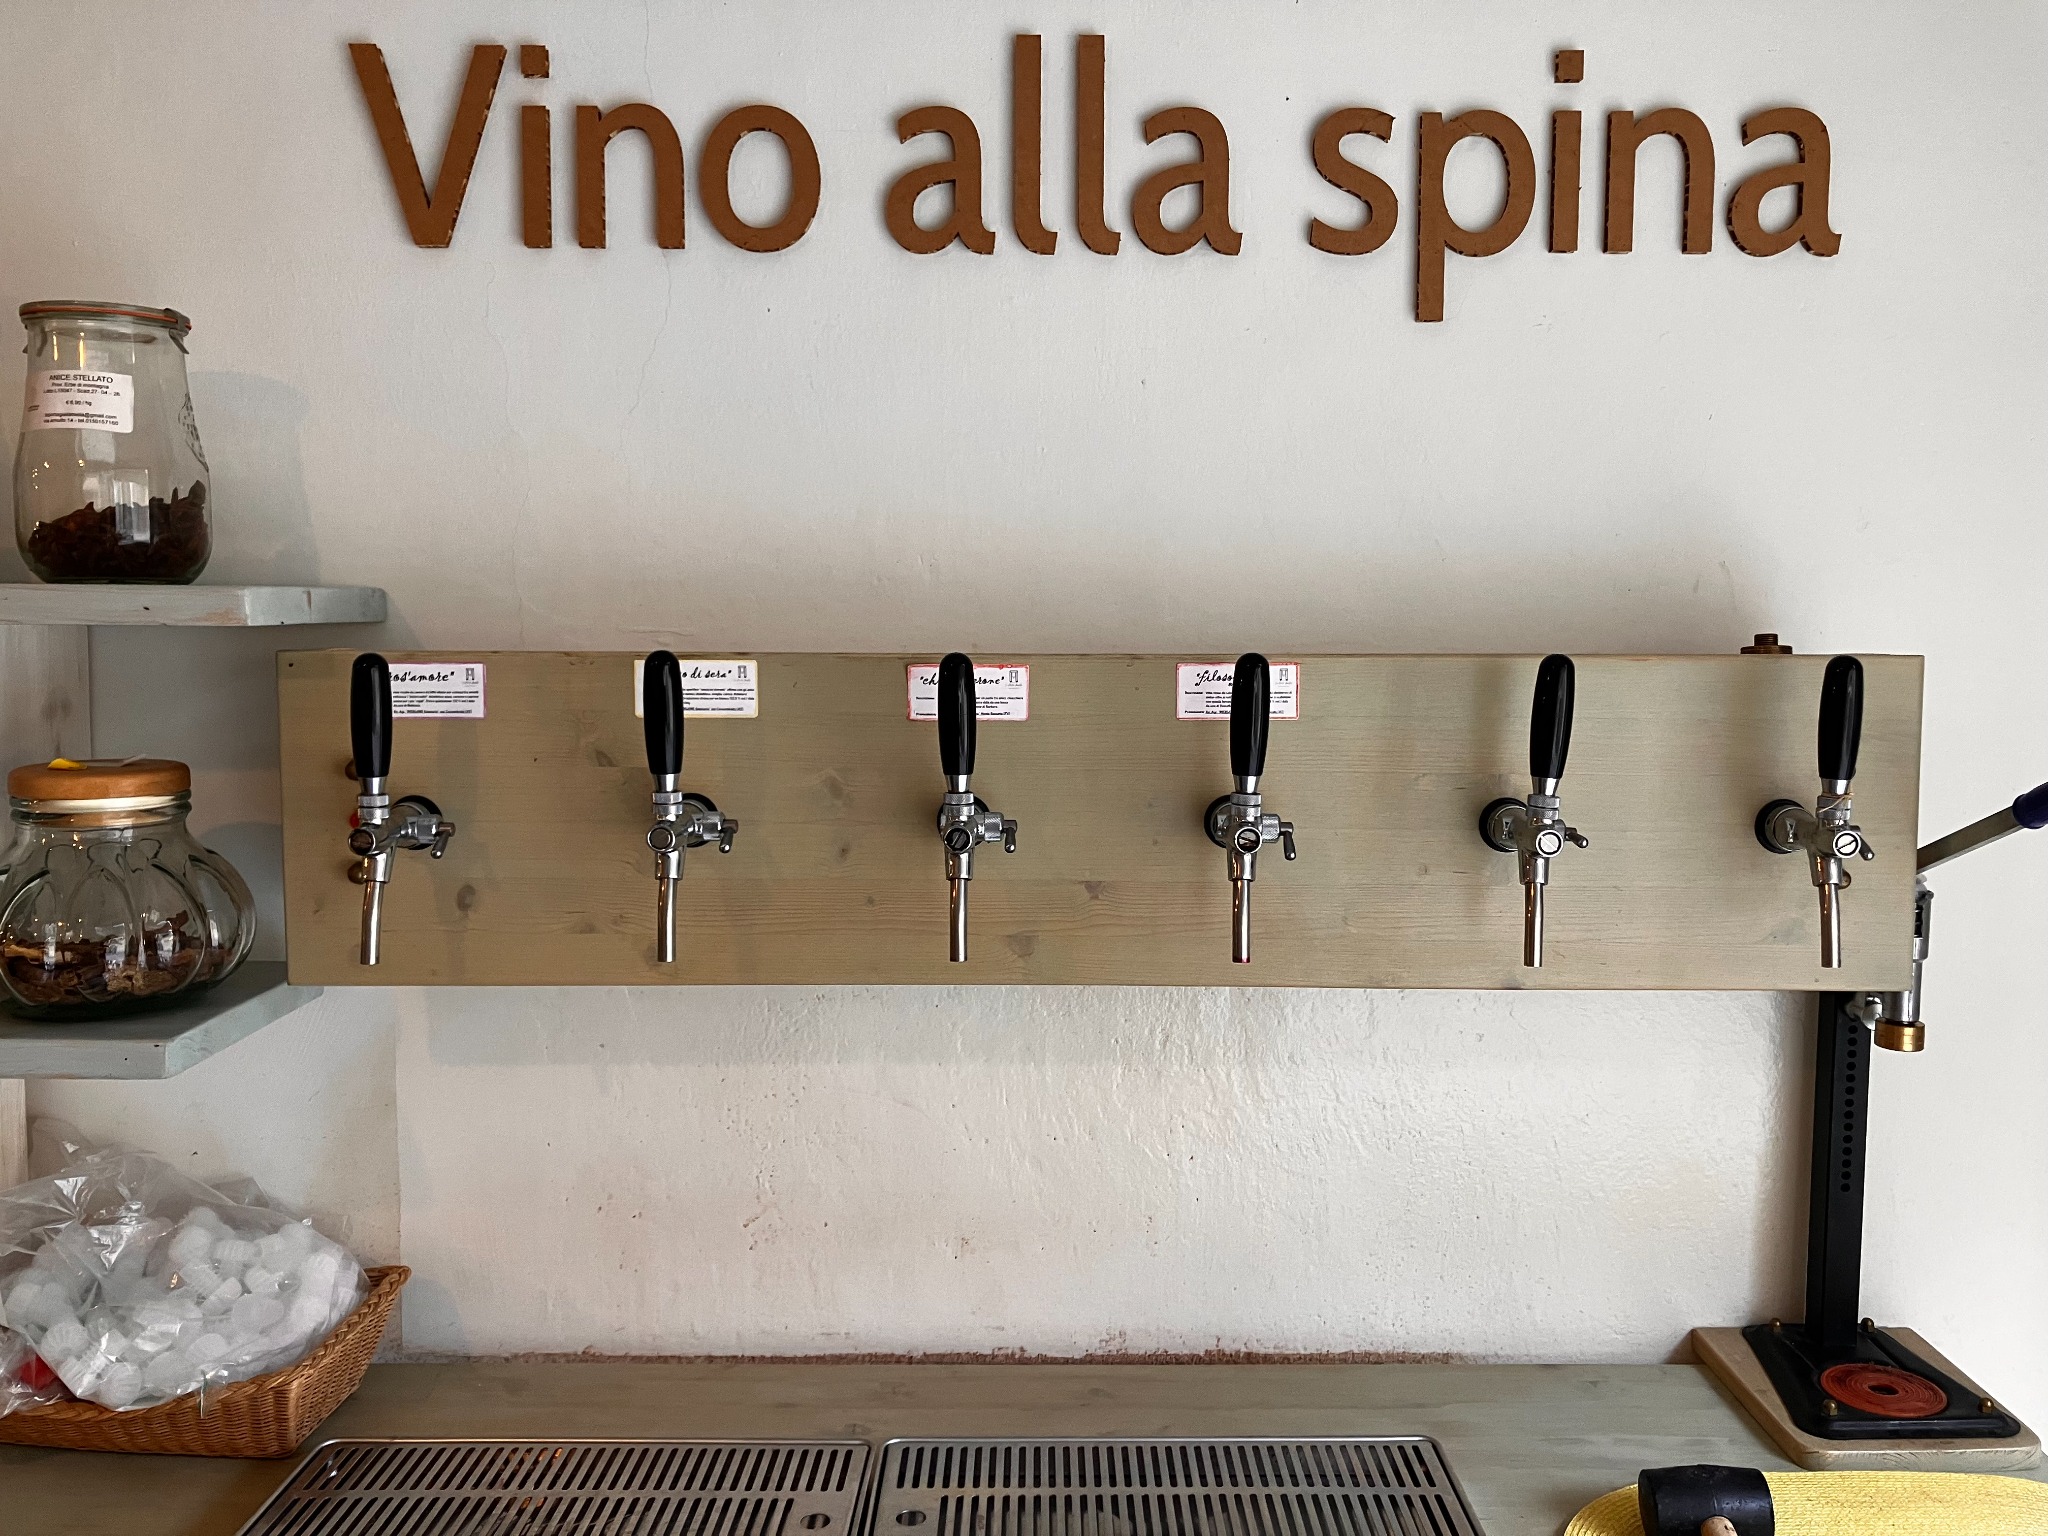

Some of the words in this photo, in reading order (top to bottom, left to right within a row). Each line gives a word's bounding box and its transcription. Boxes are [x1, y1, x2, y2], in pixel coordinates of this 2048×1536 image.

[348, 42, 822, 253] Vino
[884, 33, 1243, 255] alla
[1308, 50, 1843, 323] spina
[73, 374, 113, 384] STELLATO
